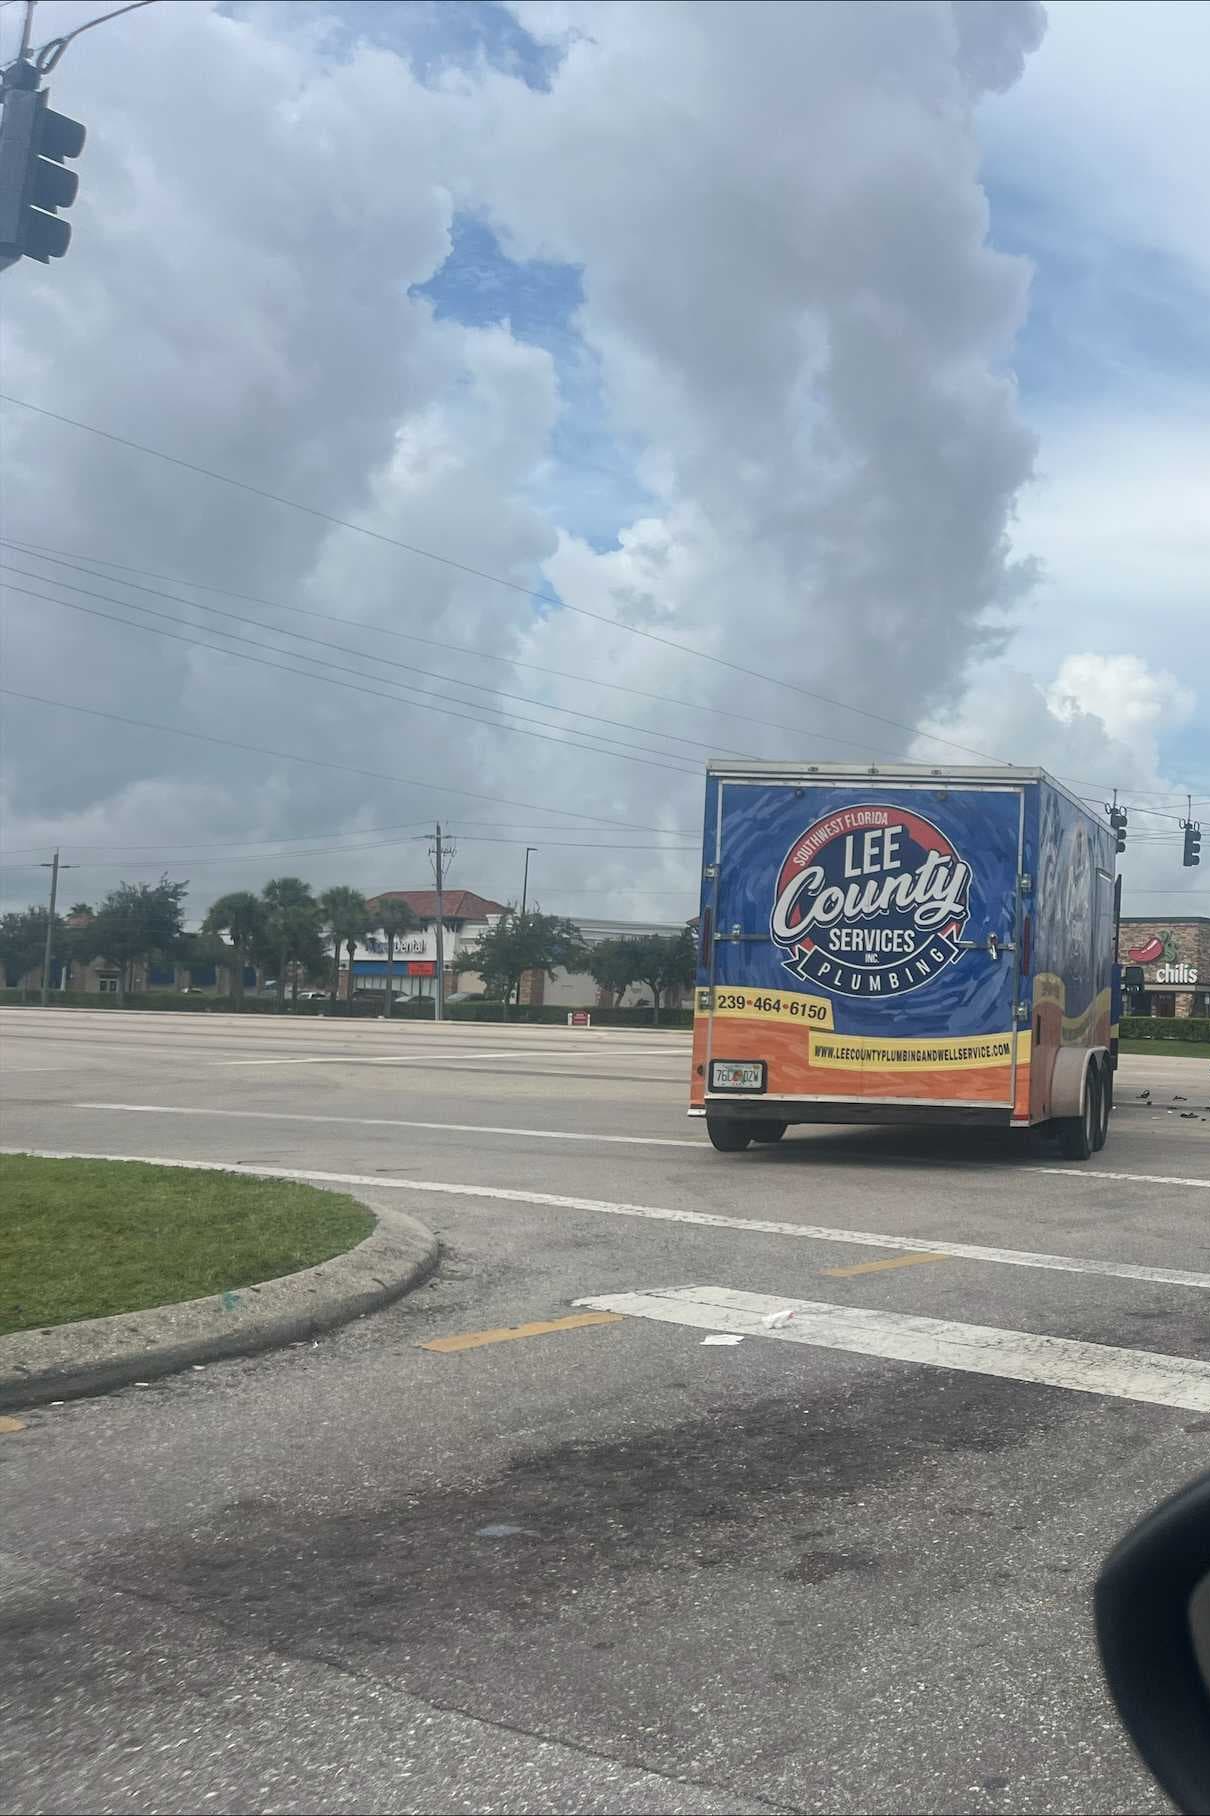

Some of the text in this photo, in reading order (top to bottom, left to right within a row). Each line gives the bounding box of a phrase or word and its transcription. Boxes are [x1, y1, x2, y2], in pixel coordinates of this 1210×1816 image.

[793, 811, 888, 866] SOUTHWEST FLORIDA
[844, 825, 903, 878] LEE
[773, 850, 967, 938] County
[829, 928, 916, 953] SERVICES
[865, 953, 880, 963] INC.
[818, 948, 945, 991] PLUMBING
[814, 1043, 1010, 1063] WWW.LEECOUNTYPLUMBINGANDWELLSERVICE.COM
